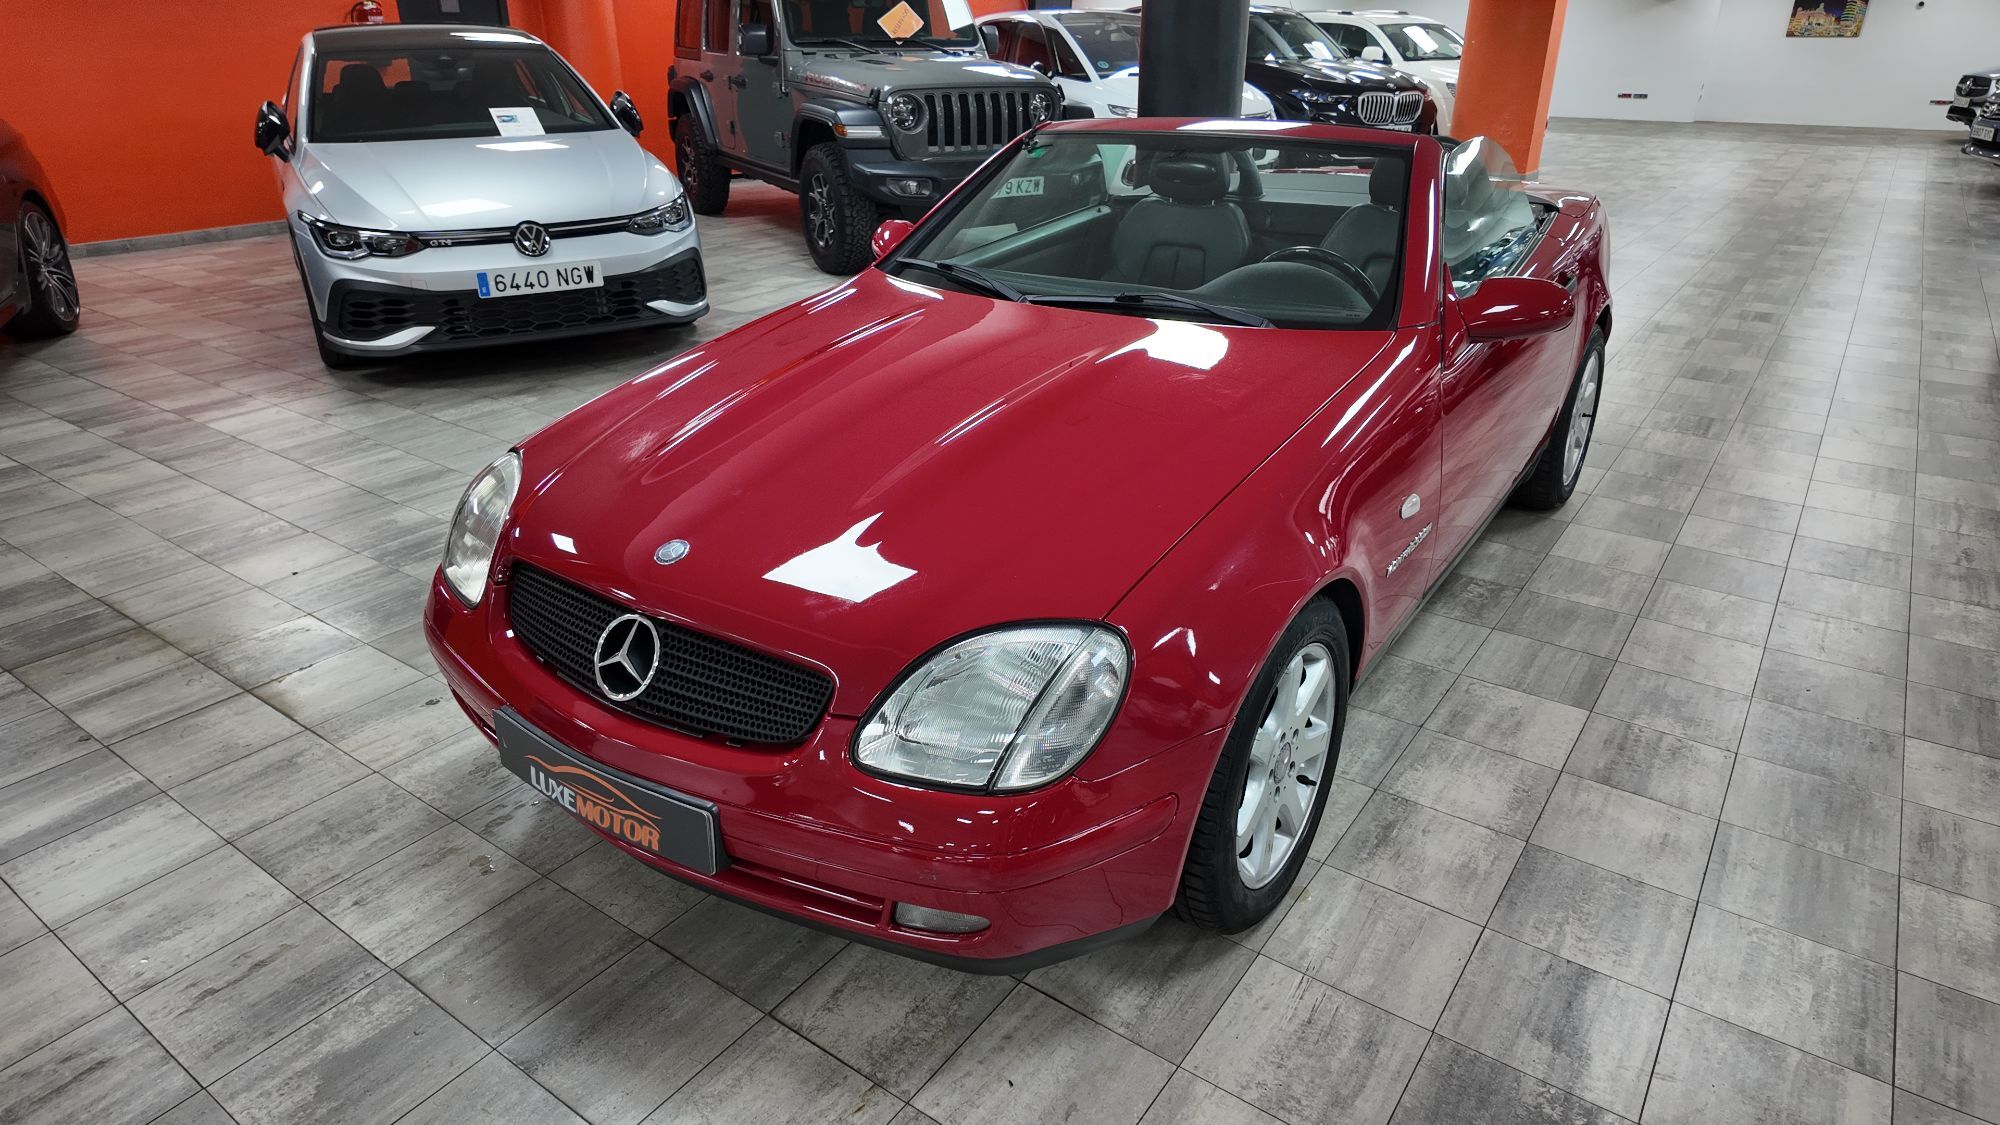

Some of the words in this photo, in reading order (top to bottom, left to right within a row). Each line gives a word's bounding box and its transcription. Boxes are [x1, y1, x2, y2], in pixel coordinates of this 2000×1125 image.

[1016, 179, 1041, 194] KZW
[494, 270, 549, 292] 6440
[556, 265, 595, 287] NGW
[530, 765, 661, 851] LUXEMOTOR
